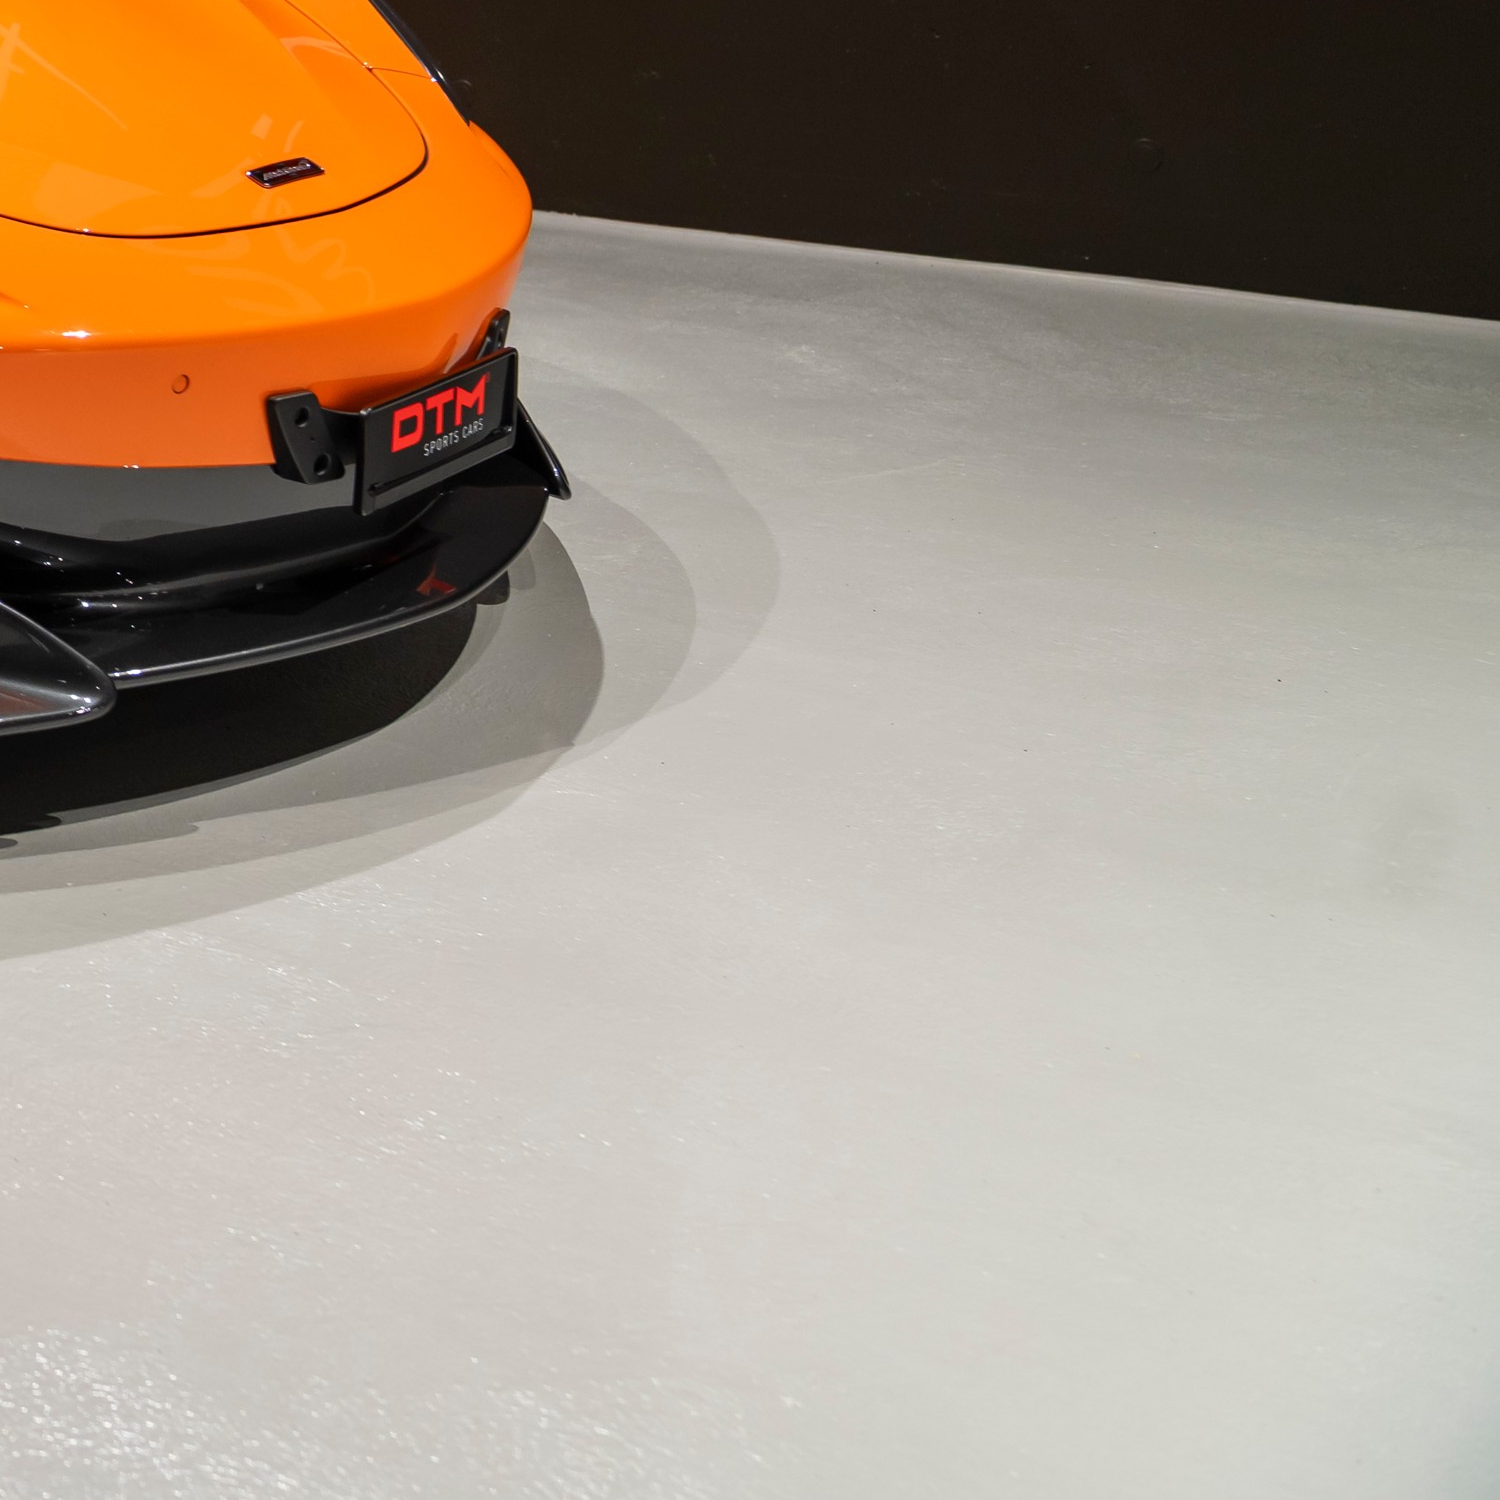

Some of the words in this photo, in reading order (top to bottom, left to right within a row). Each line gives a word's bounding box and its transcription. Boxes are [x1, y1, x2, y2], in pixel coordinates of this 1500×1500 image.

[391, 374, 487, 453] DTM
[423, 430, 459, 457] SPORTS
[461, 417, 484, 439] CARS
